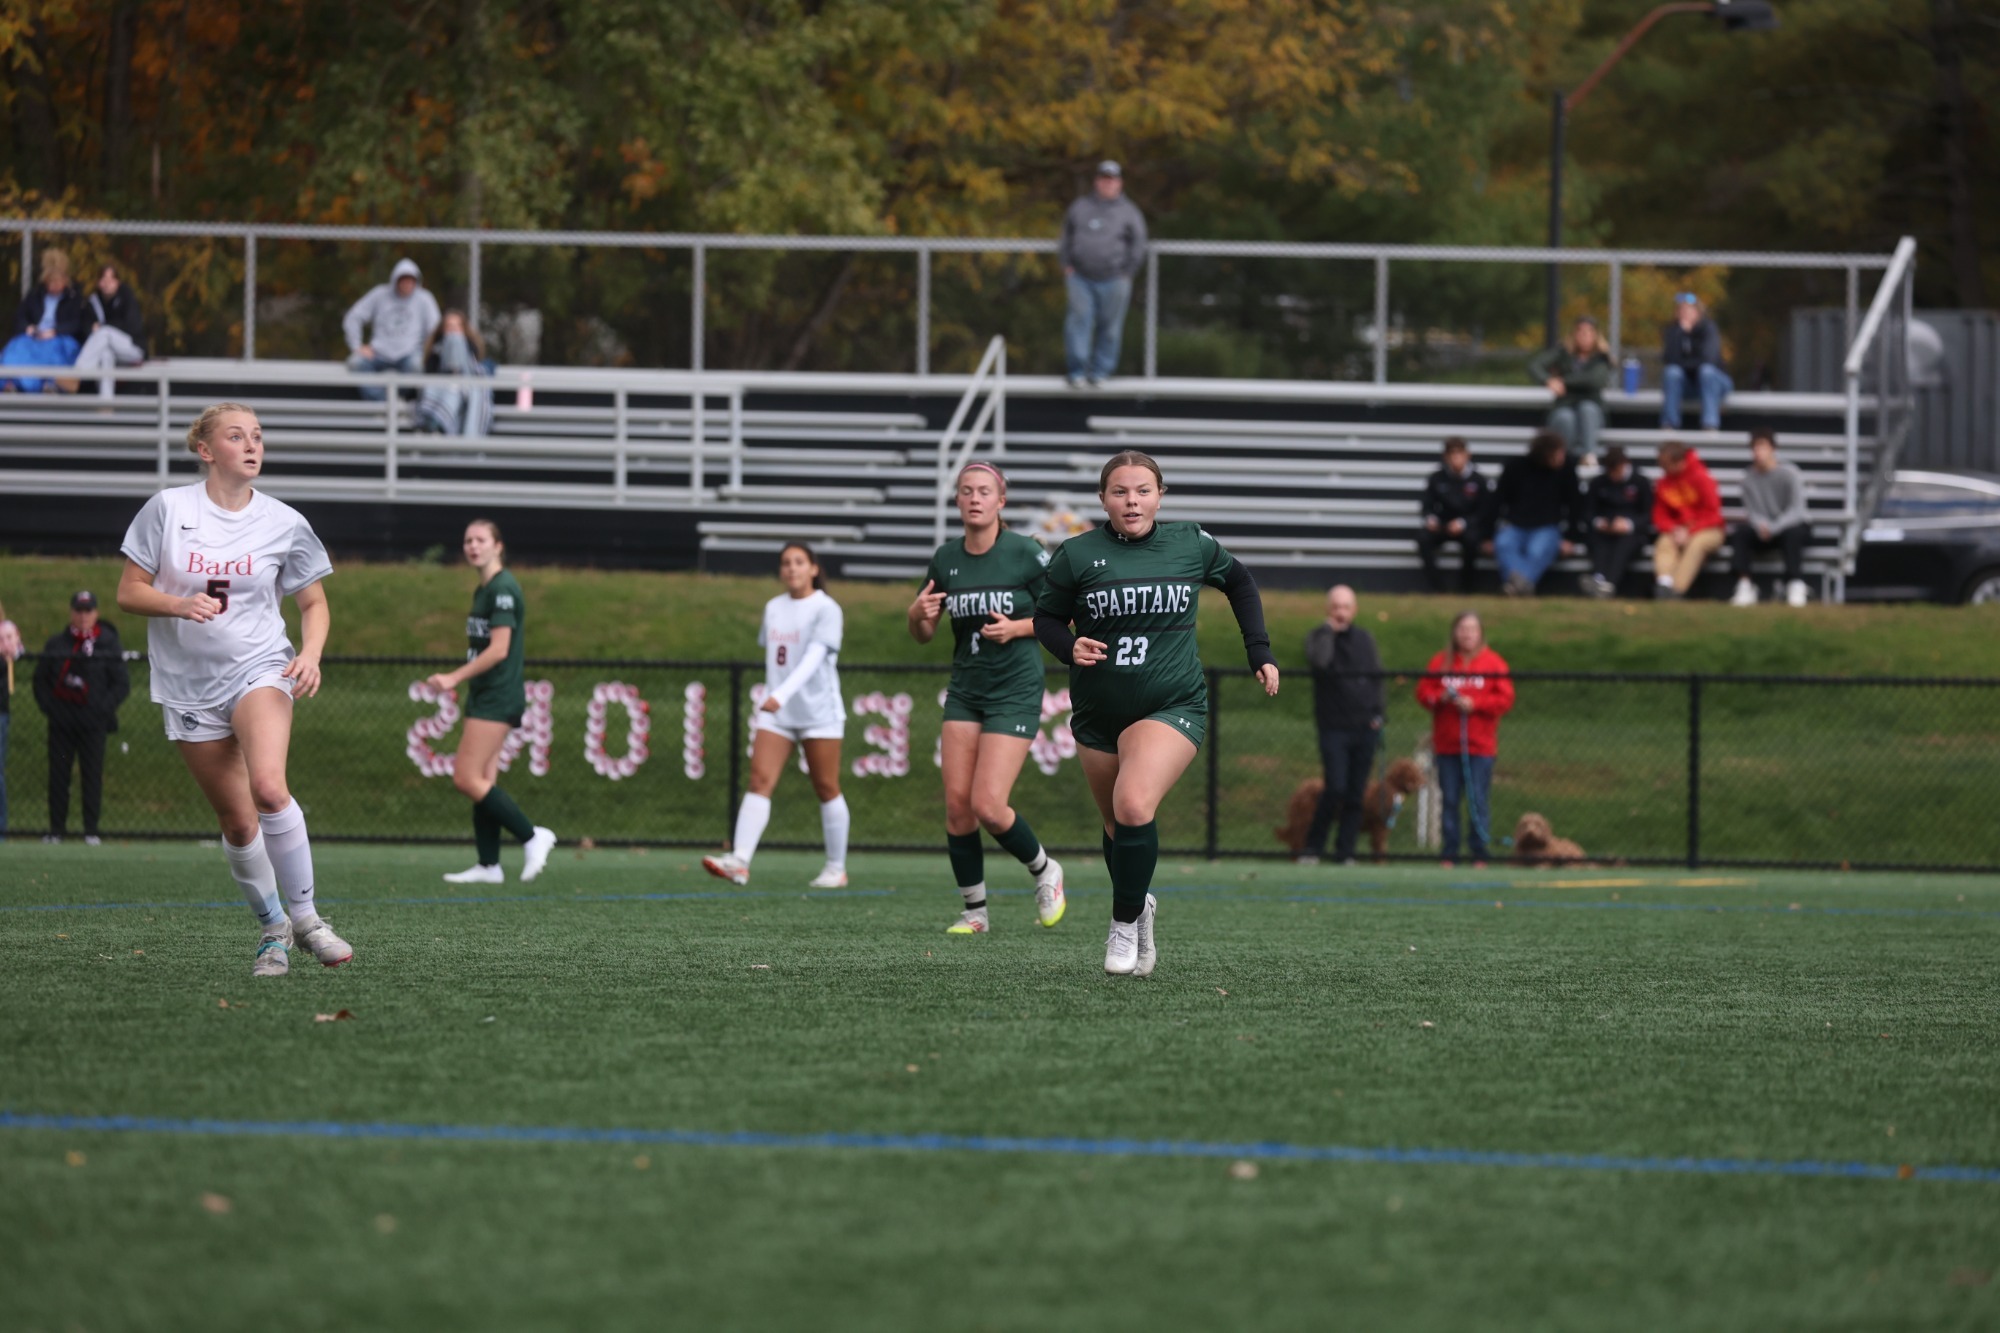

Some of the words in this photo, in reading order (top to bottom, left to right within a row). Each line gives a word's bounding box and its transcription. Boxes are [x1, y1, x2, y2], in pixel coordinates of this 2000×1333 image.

[186, 552, 253, 576] Bard
[206, 579, 230, 615] 5
[945, 591, 1014, 618] PARTANS
[1086, 584, 1192, 620] SPARTANS
[776, 645, 787, 667] 8
[1115, 636, 1149, 666] 23
